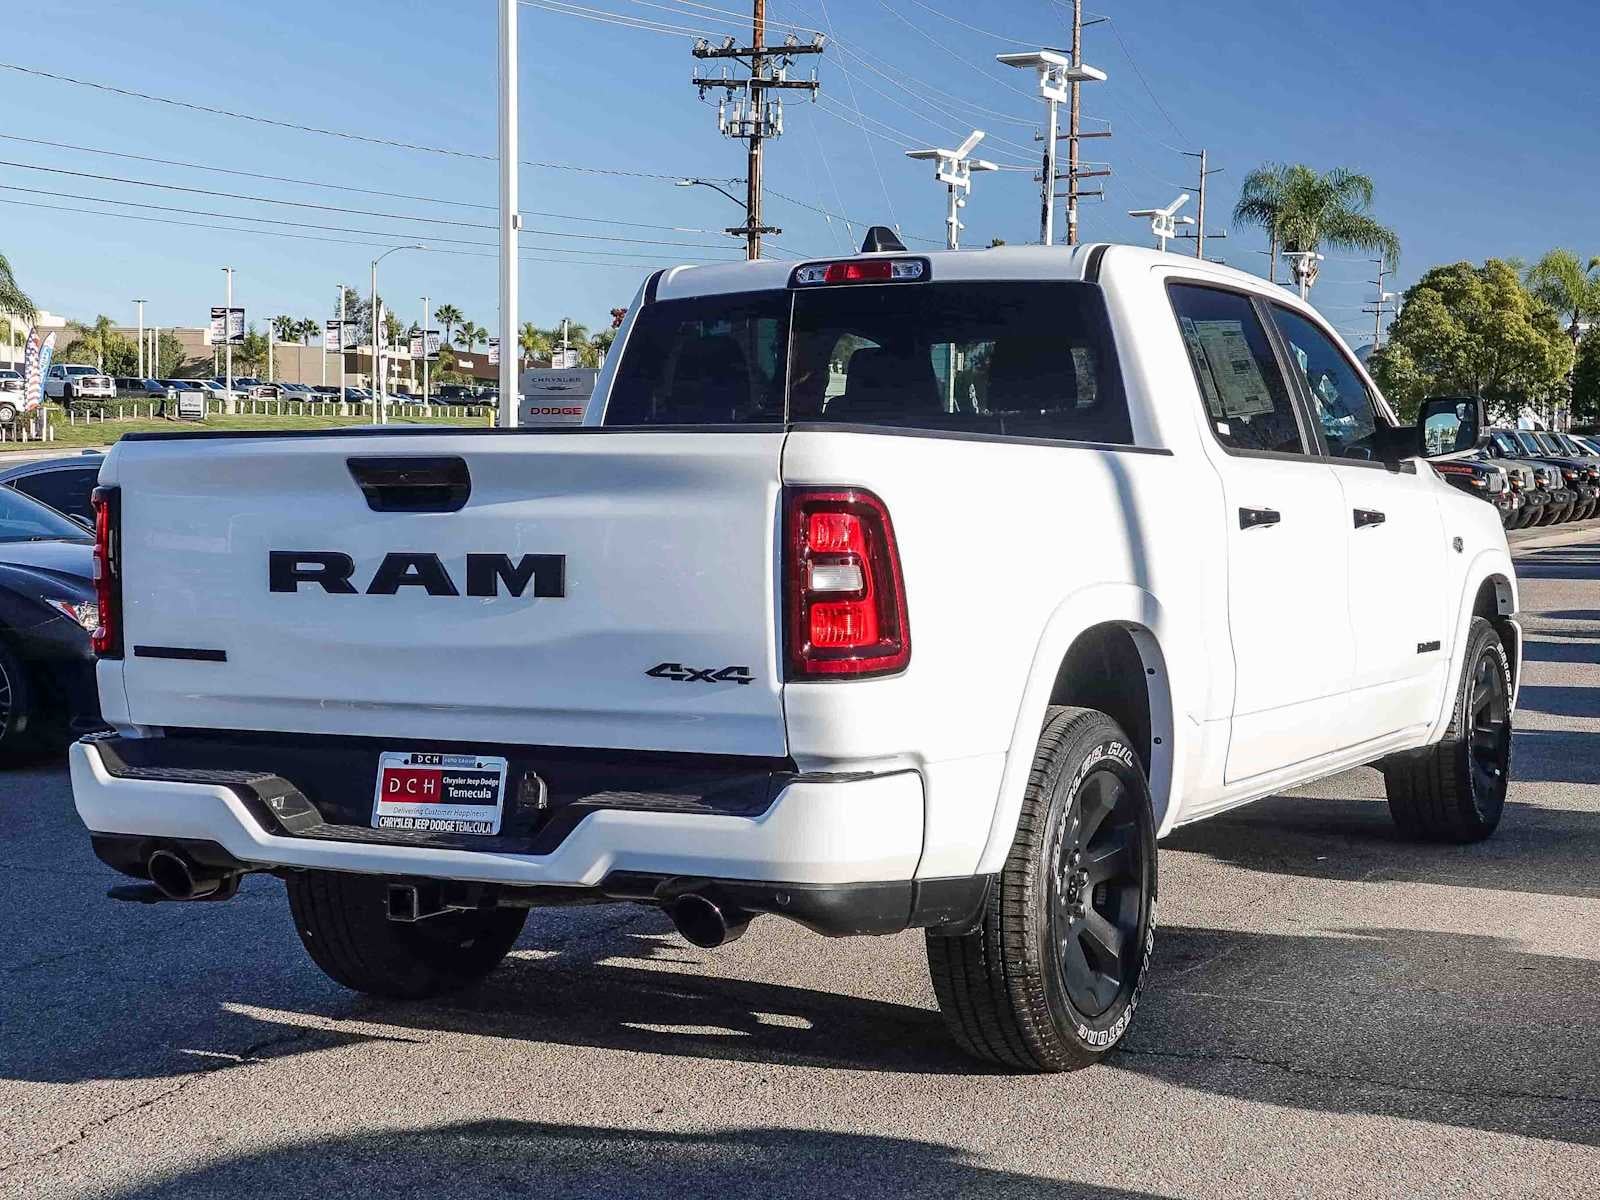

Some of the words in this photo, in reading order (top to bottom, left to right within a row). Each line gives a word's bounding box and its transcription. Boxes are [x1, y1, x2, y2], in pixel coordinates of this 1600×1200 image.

[530, 407, 583, 415] DODGE
[269, 550, 566, 598] RAM
[644, 662, 757, 685] 4x4
[442, 776, 466, 786] Chrysler
[466, 777, 480, 787] Jeep
[480, 777, 499, 787] Dodge
[448, 786, 492, 799] Temecula
[393, 806, 424, 815] Delivering
[425, 807, 453, 816] Customer
[379, 816, 414, 829] CHRYSLER
[413, 818, 430, 831] JEEP
[430, 819, 455, 832] DODGE
[455, 821, 491, 833] TEMECULA
[1077, 896, 1158, 1046] BRIDGESTONE
